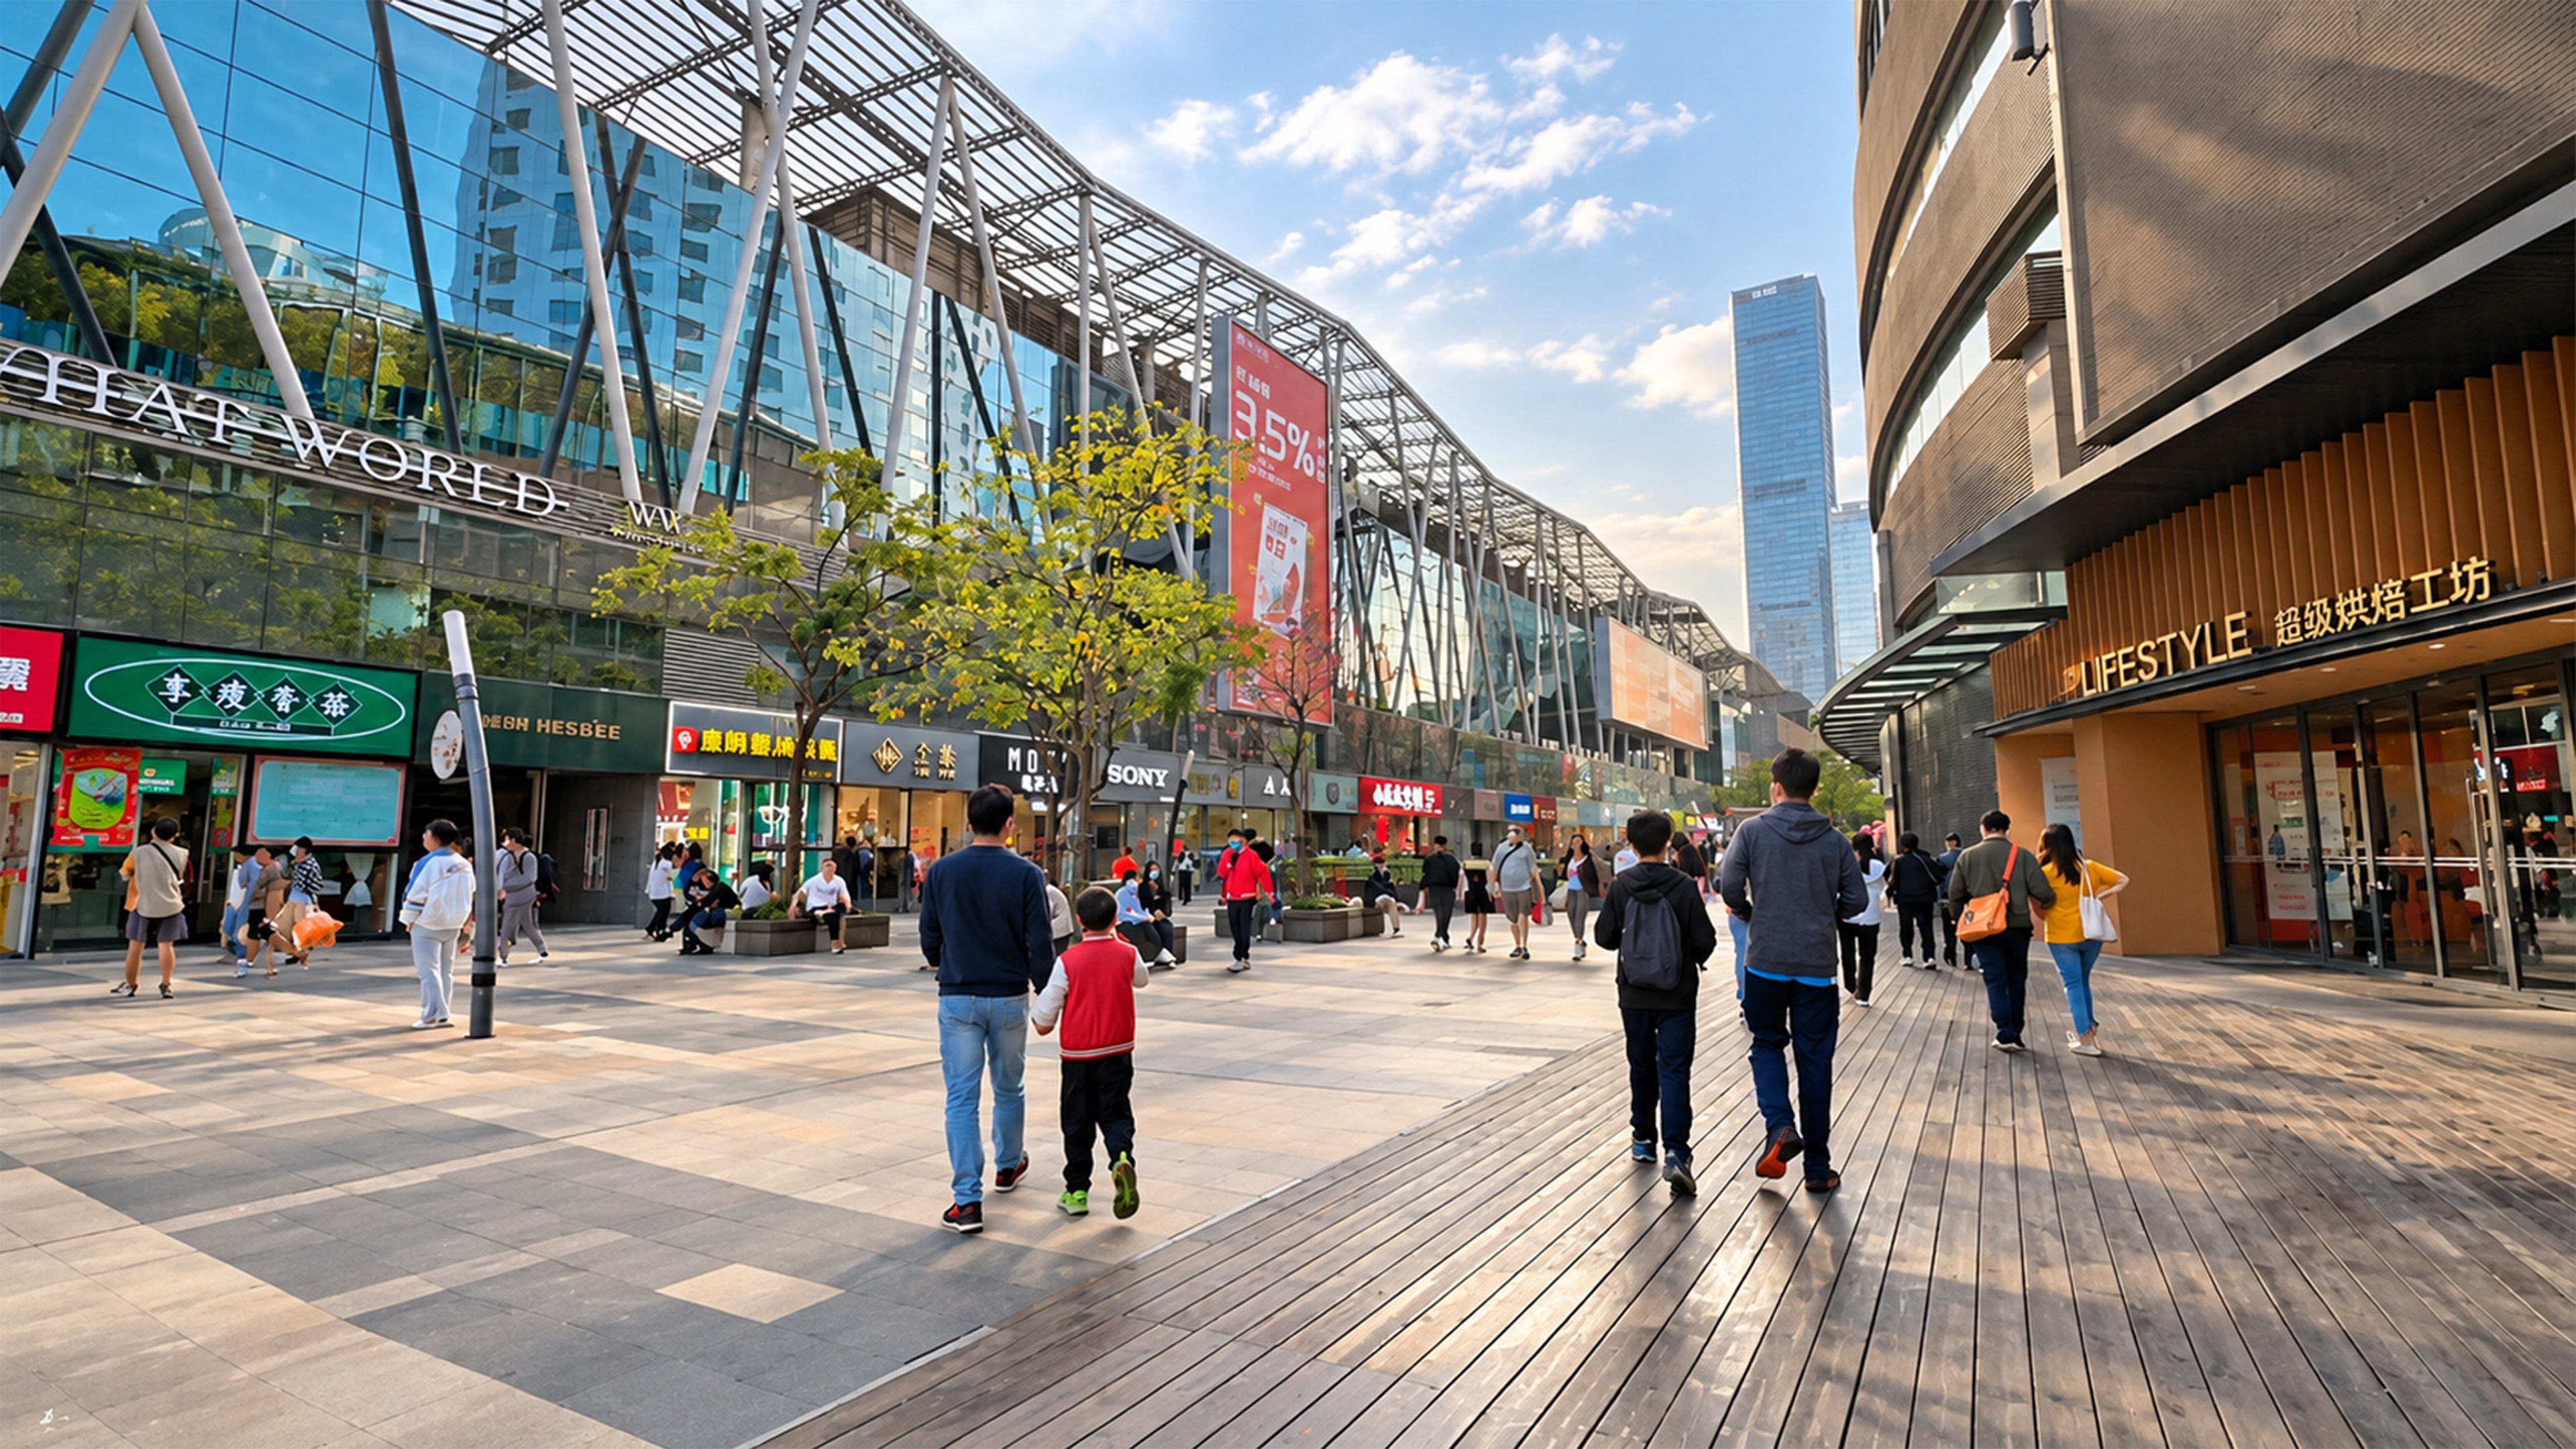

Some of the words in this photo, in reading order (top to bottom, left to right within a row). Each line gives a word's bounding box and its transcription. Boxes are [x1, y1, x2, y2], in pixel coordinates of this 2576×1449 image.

[279, 413, 558, 517] WORLD
[2274, 556, 2491, 647] 超级烘焙工坊
[2080, 611, 2253, 696] LIFESTYLE
[1008, 747, 1067, 773] MO
[1108, 763, 1169, 788] SONY
